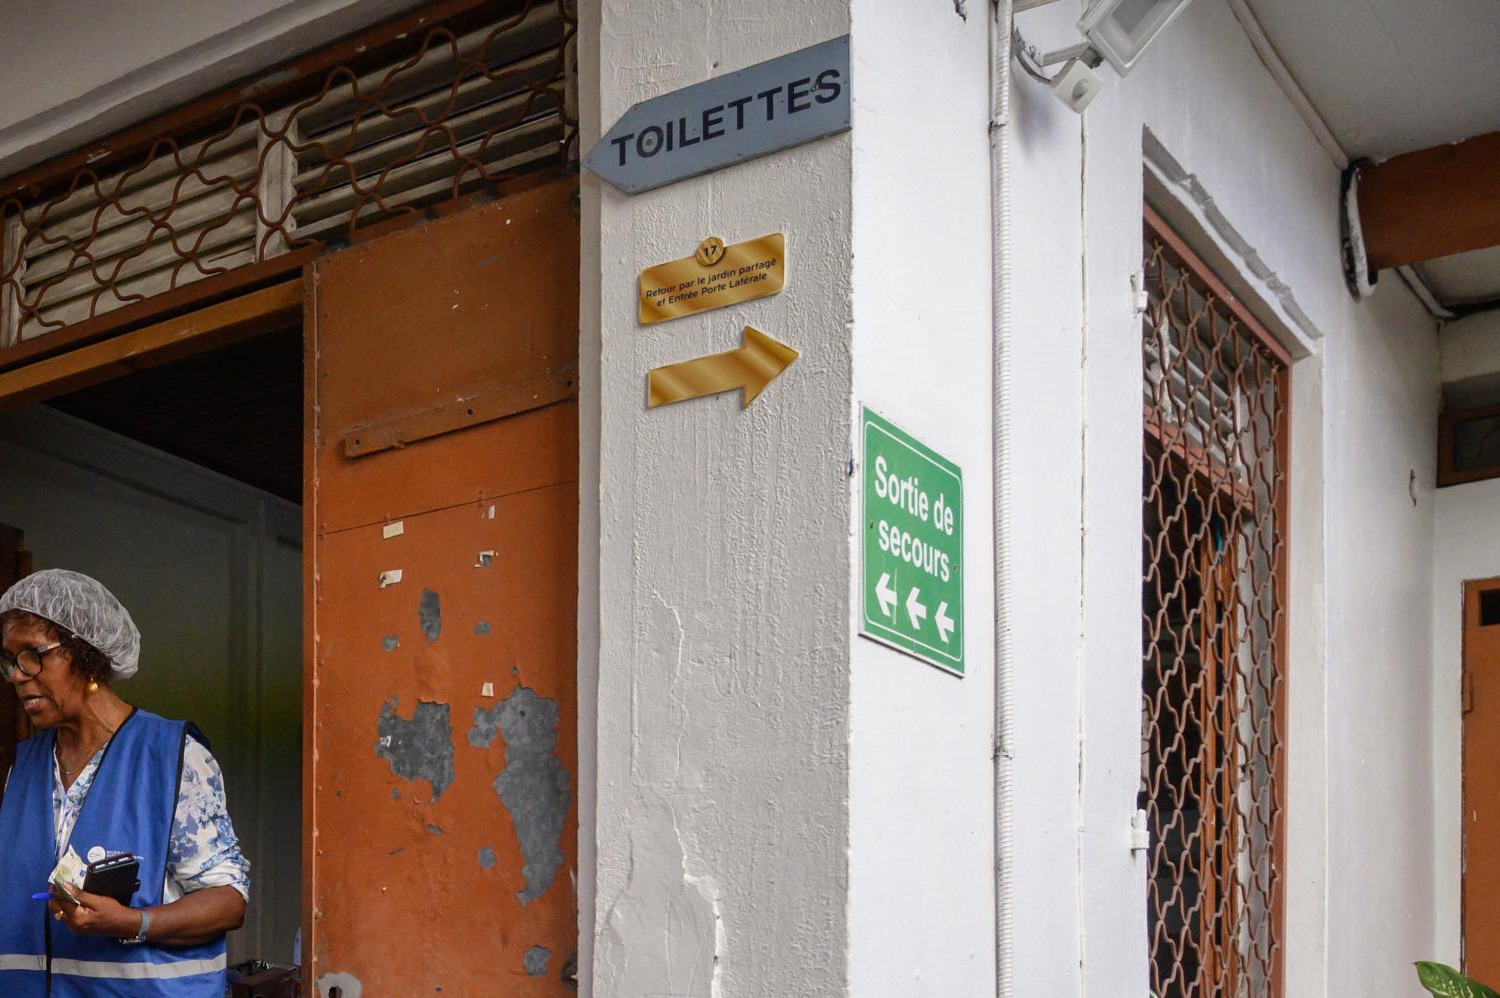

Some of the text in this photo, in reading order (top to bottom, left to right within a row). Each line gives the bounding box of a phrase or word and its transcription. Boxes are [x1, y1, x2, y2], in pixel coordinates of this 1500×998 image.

[611, 69, 842, 167] TOILETTES
[703, 245, 717, 257] 17
[645, 258, 777, 298] Retour par le jardin partagé
[656, 273, 768, 307] et Entrée Porte Latérale
[875, 455, 954, 536] Sortie de
[878, 520, 950, 583] secours
